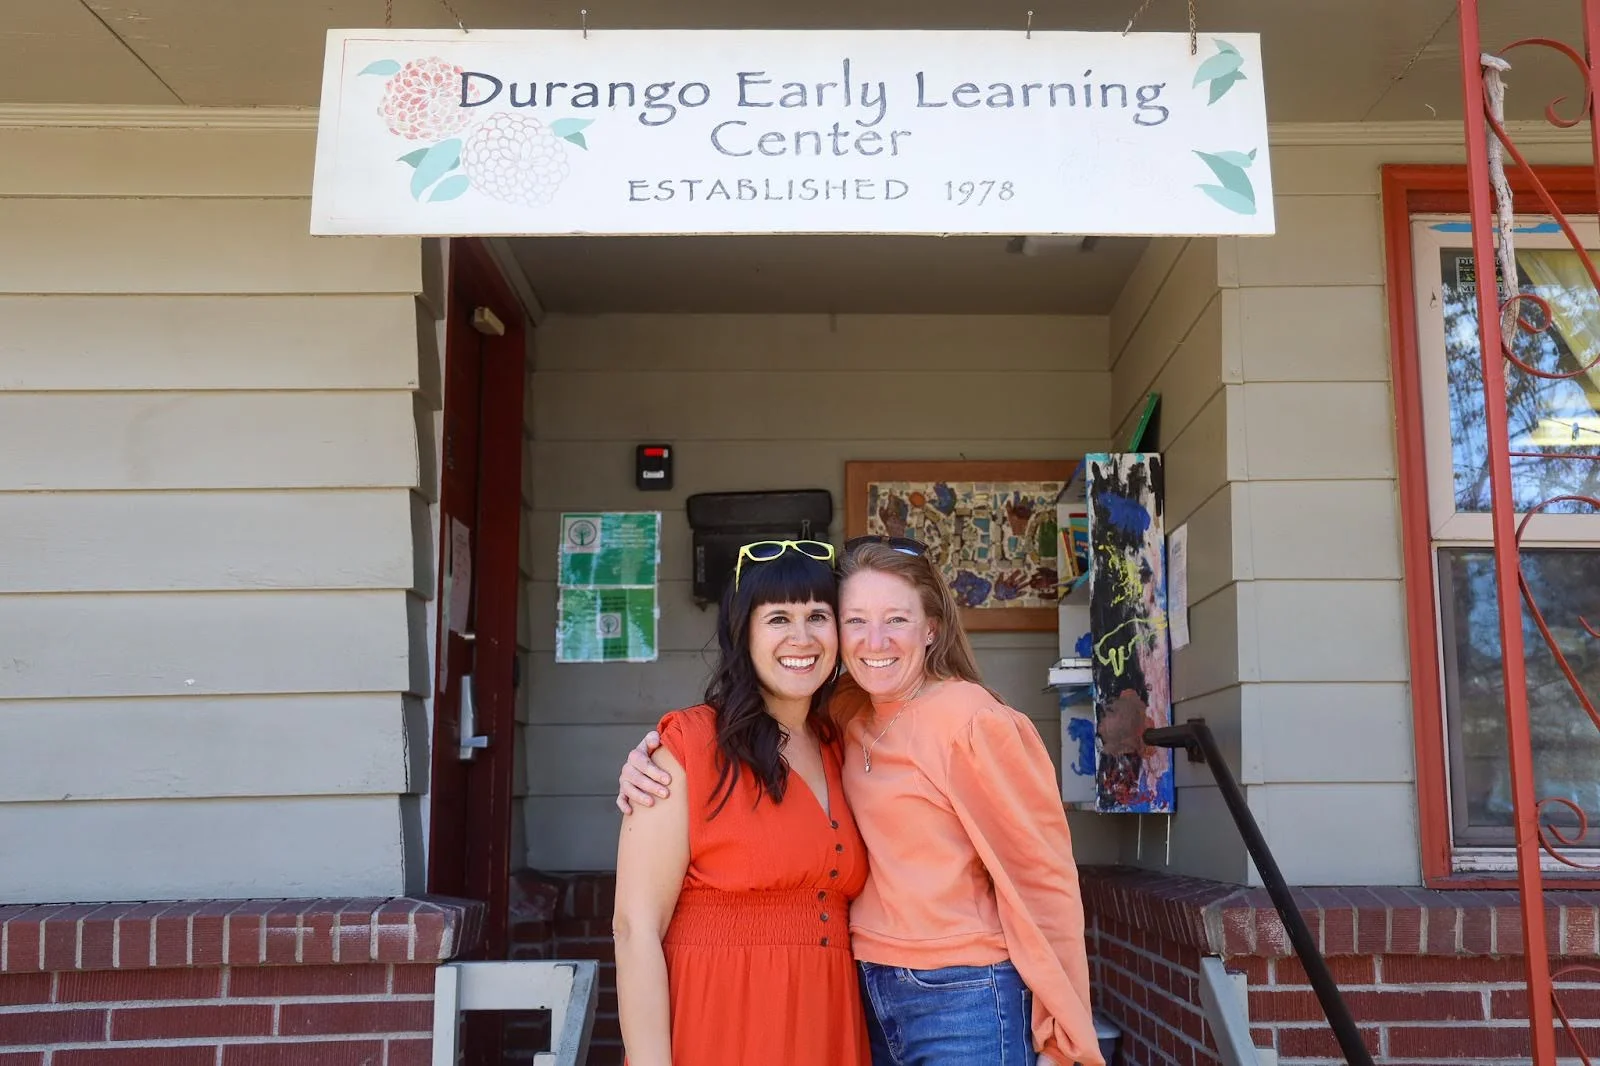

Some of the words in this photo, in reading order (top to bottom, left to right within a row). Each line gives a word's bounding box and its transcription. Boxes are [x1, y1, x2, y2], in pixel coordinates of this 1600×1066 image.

[459, 71, 711, 126] Durango
[737, 58, 887, 127] Early
[916, 69, 1169, 127] Learning
[711, 121, 912, 157] Center
[628, 178, 909, 203] ESTABLISHED
[945, 180, 1015, 206] 1978
